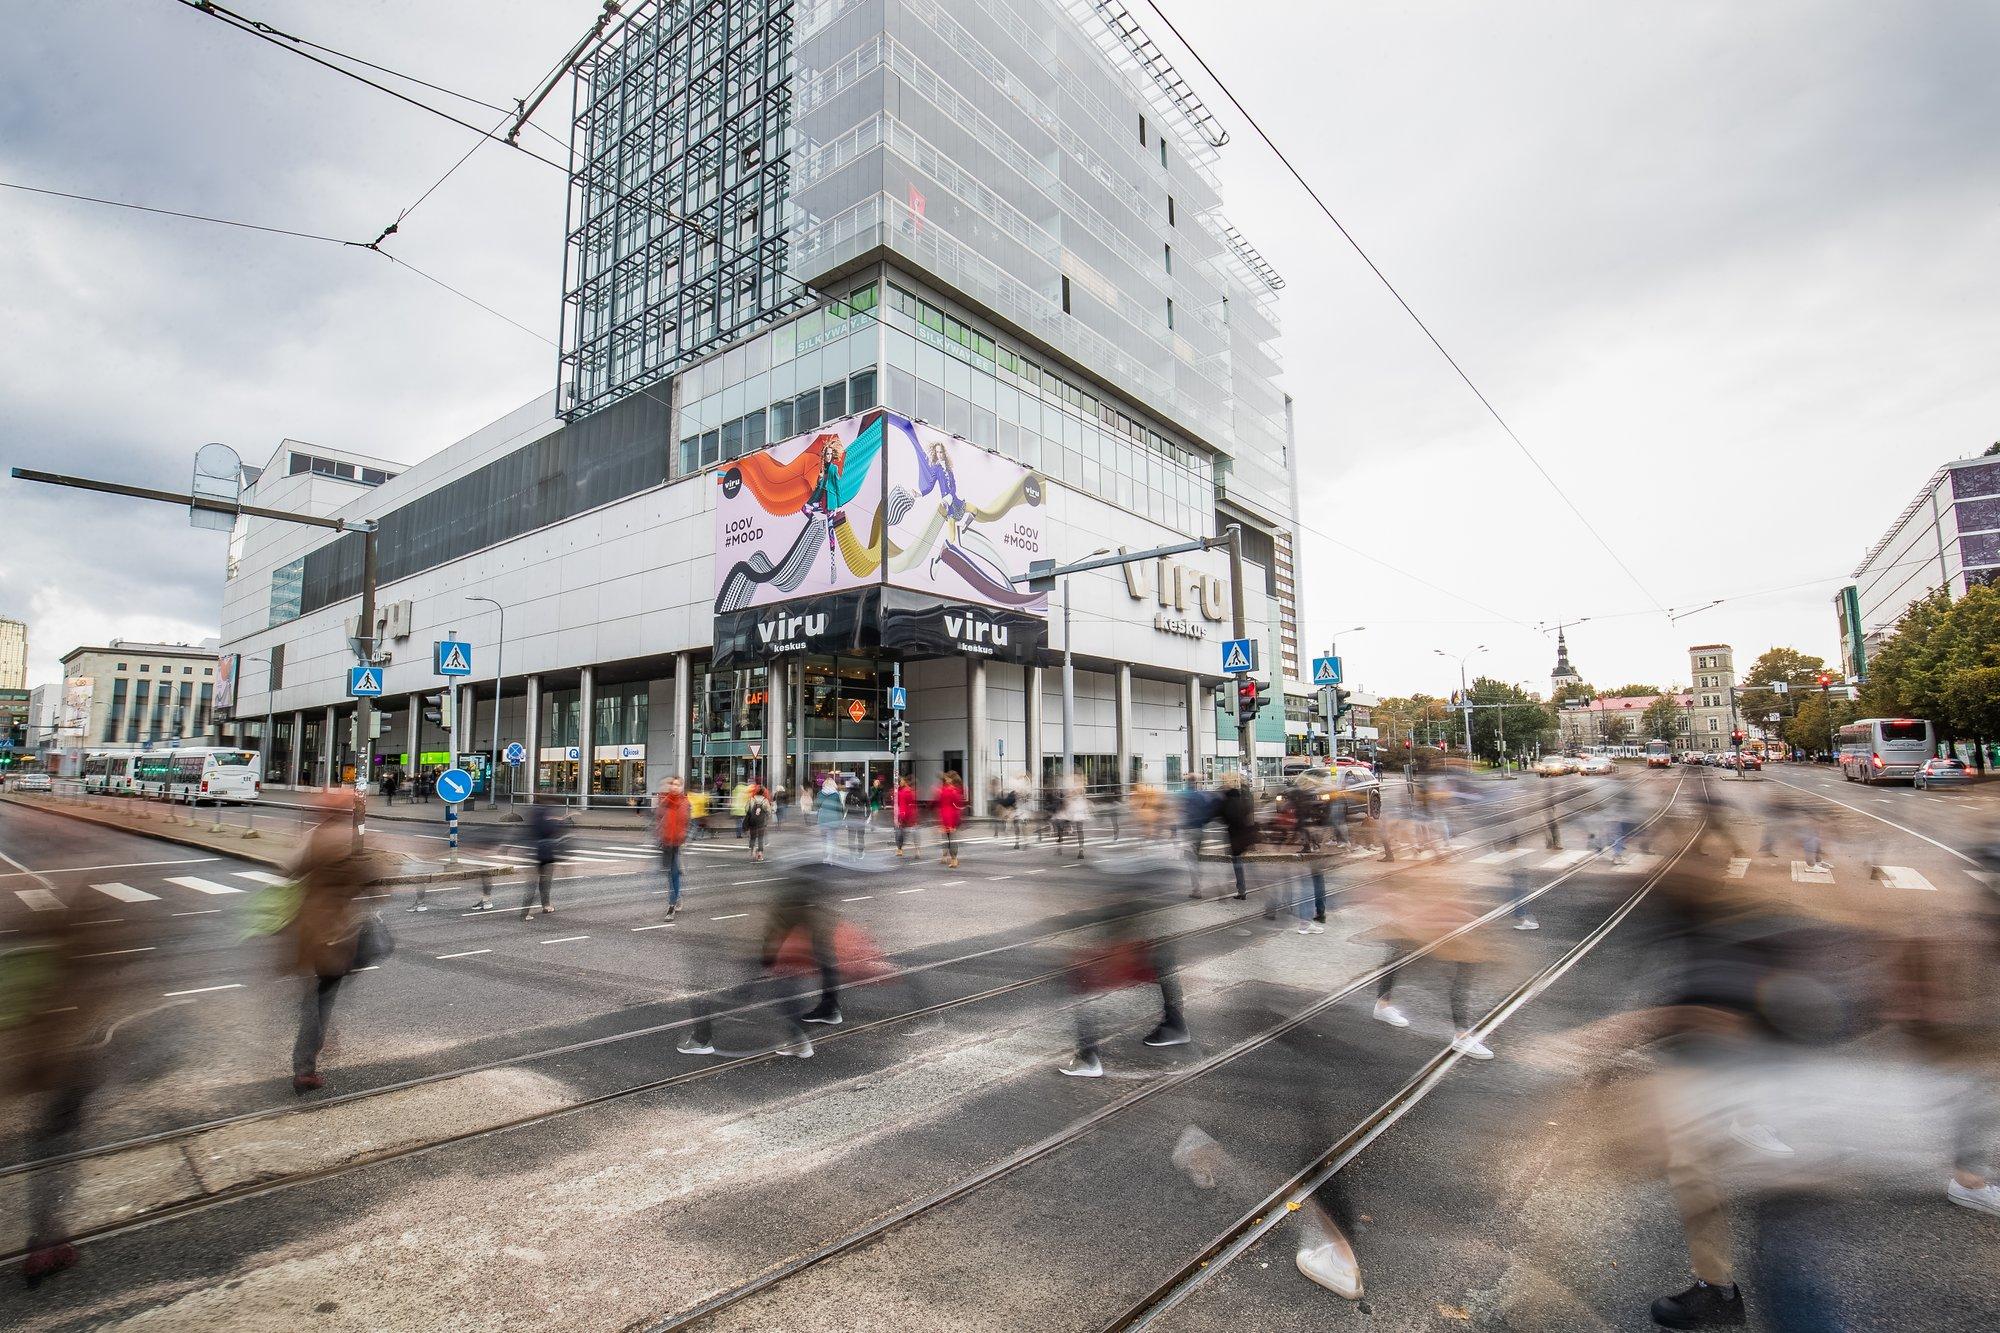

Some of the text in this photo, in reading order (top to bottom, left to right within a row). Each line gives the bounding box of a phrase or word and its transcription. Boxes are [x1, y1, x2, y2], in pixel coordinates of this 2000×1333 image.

[798, 309, 877, 352] SILKYWAY.EE
[918, 328, 989, 370] SILKYWAY.EE
[725, 479, 740, 489] viru
[1025, 486, 1040, 497] viru
[725, 516, 753, 534] LOOV
[1014, 522, 1039, 540] LOOV
[725, 528, 764, 547] #MOOD
[1004, 533, 1039, 553] #MOOD
[1118, 546, 1230, 622] viru
[757, 612, 825, 643] viru
[944, 612, 1008, 646] viru
[1154, 612, 1208, 638] keskus
[773, 642, 807, 653] keskus
[961, 642, 993, 655] keskus
